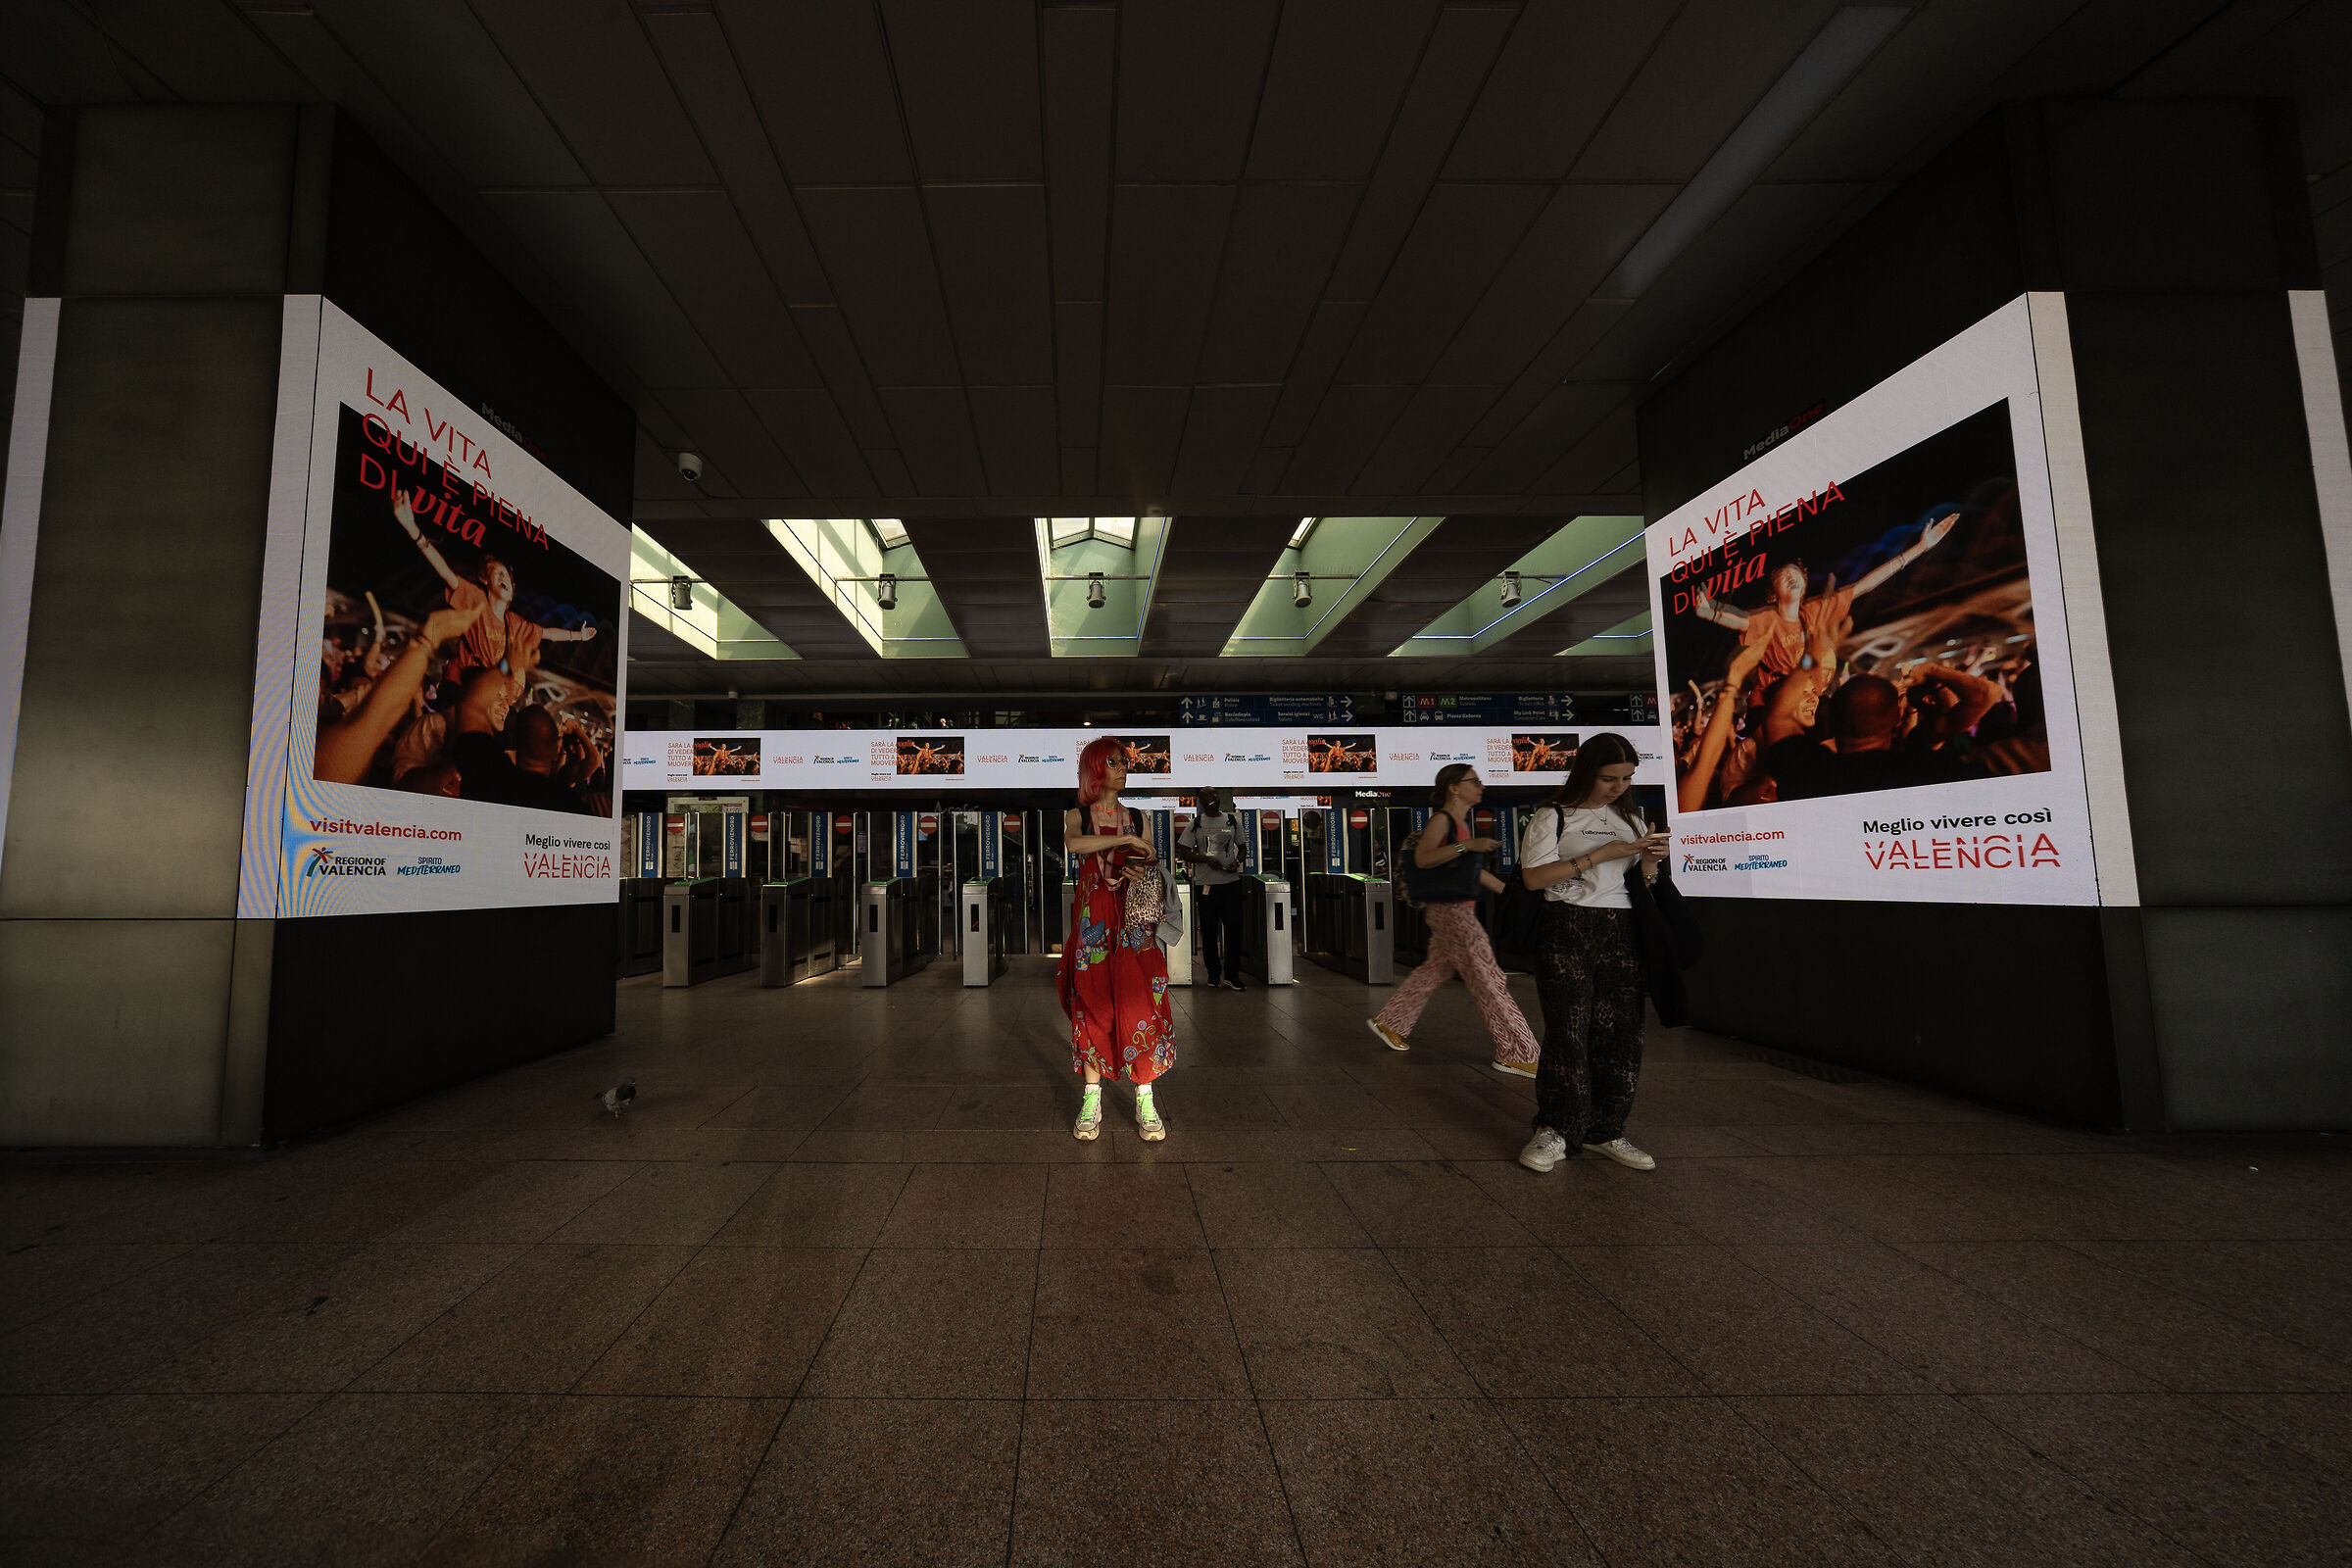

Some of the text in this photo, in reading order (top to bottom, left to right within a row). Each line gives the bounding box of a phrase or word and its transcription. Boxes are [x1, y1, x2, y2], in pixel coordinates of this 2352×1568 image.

[366, 368, 492, 479] LA VITA
[481, 402, 549, 463] MediaOne
[1742, 402, 1826, 461] MediaOne
[363, 413, 549, 551] QUI È PIENA
[360, 453, 486, 548] DI vita
[1669, 488, 1766, 558] LA VITA
[1671, 480, 1845, 583] QUI È PIENA
[1673, 553, 1767, 615] DI vita
[310, 817, 462, 842] visitvalencia.com
[1862, 808, 2052, 837] Meglio vivere così
[525, 834, 611, 851] Meglio vivere così
[1680, 828, 1785, 846] visitvalencia.com
[1864, 832, 2061, 870] VALENCIA
[319, 864, 386, 876] VALENCIA
[335, 856, 386, 866] REGION OF
[397, 863, 461, 877] MEDITERRANEO
[417, 857, 442, 865] SPIRITO
[524, 852, 611, 879] VALENCIA
[1688, 863, 1728, 872] VALENCIA
[1734, 859, 1788, 872] MEDITERRANEO
